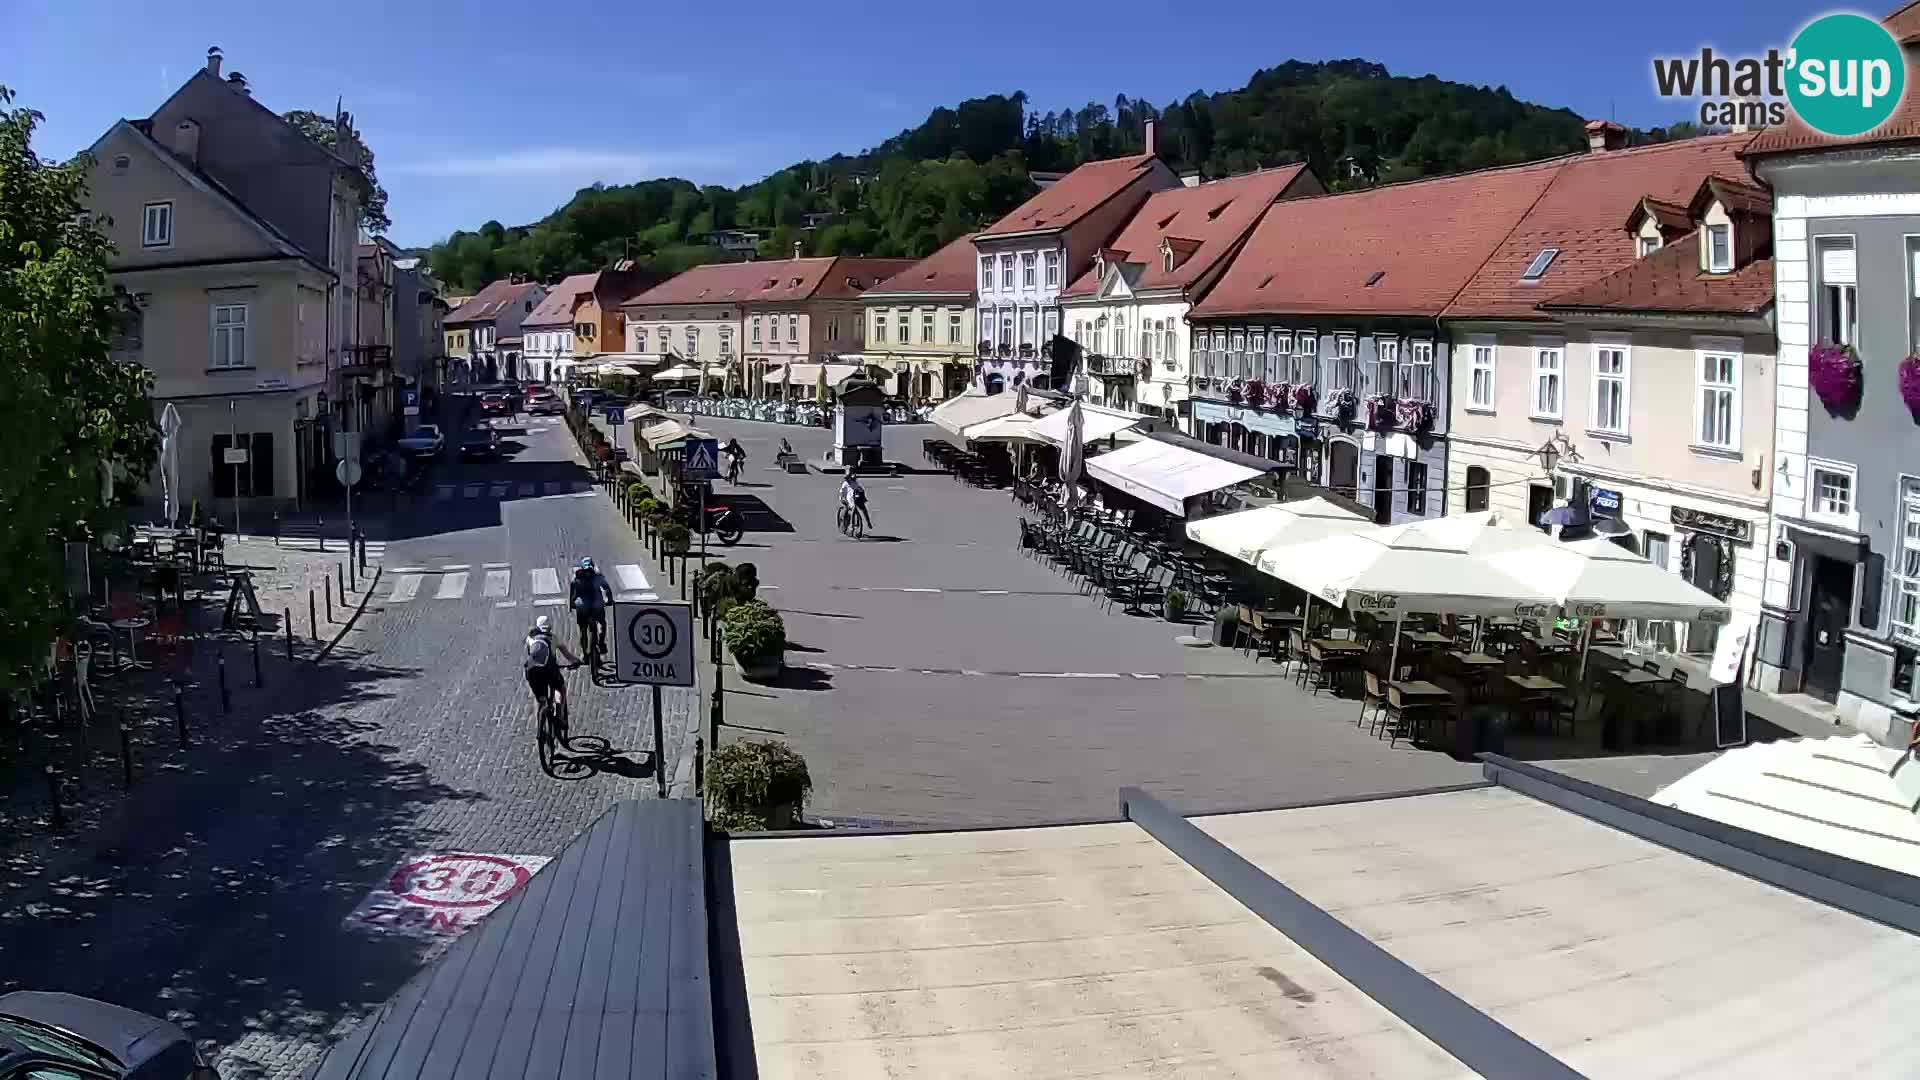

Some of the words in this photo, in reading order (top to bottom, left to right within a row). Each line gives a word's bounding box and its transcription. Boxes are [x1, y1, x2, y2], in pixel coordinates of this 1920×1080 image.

[641, 624, 666, 646] 30
[631, 661, 677, 679] ZONA
[417, 867, 504, 895] 30
